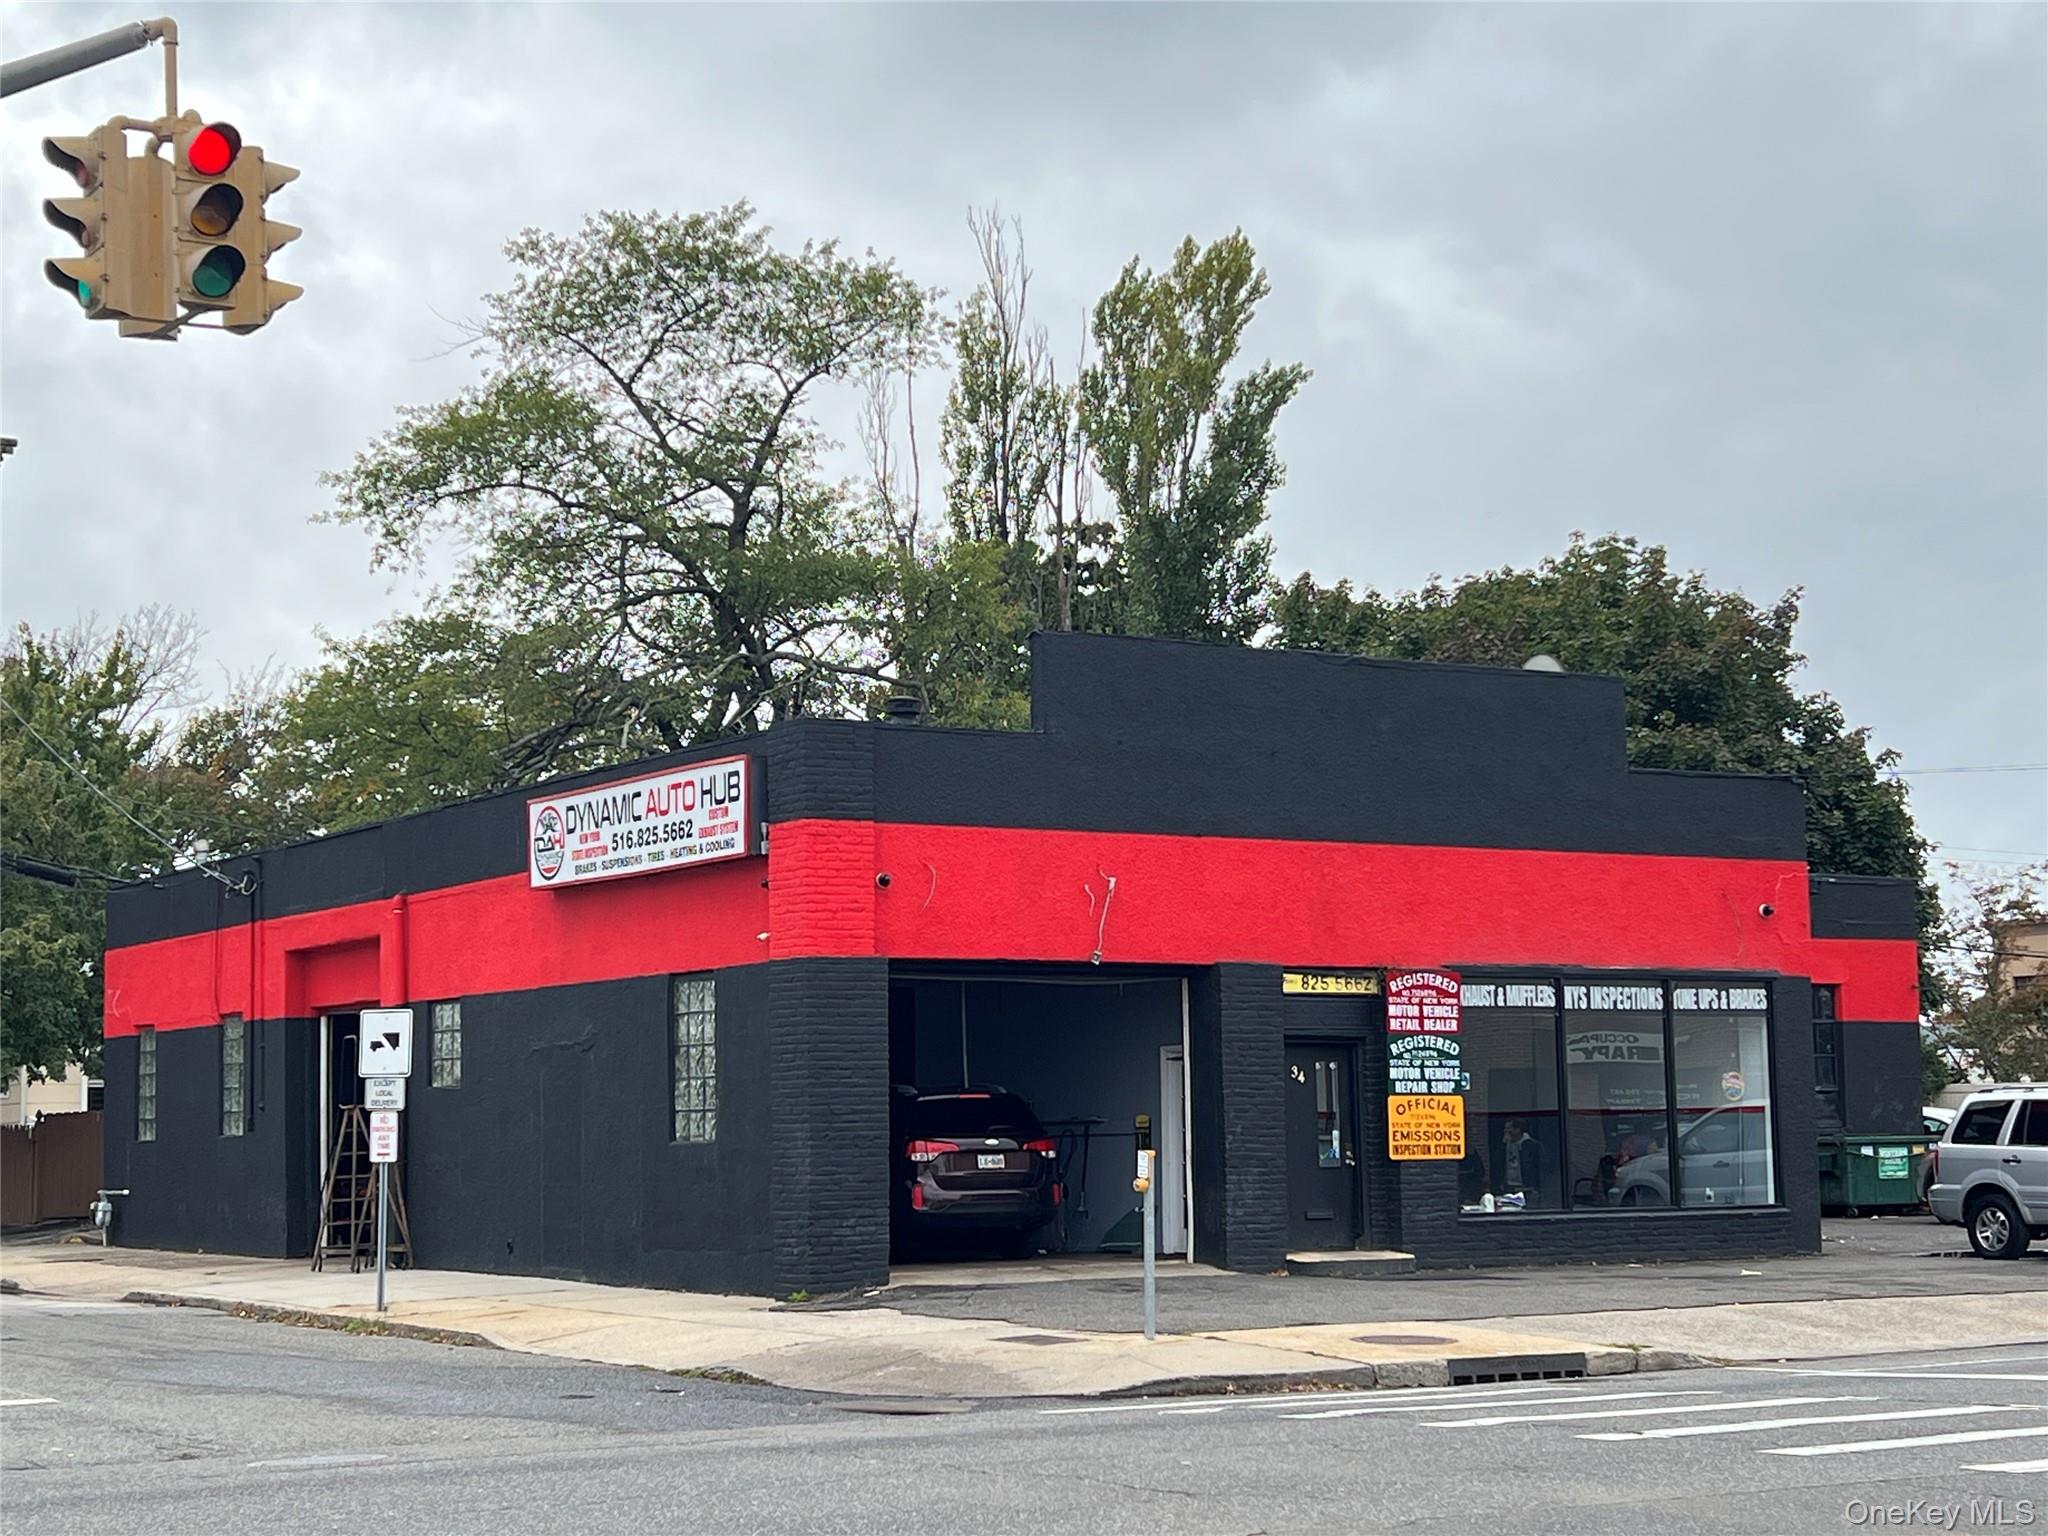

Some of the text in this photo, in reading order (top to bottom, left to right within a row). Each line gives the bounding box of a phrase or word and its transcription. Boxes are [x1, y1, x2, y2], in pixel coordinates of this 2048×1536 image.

[566, 770, 740, 834] DYNAMIC AUTO HUB
[612, 819, 693, 851] 516.825.5662
[574, 861, 597, 875] BRAKES
[601, 855, 643, 871] SUSPENSIONS
[647, 851, 665, 863] TIRES
[670, 845, 697, 859] HEATING
[705, 837, 735, 853] COOLING
[1389, 973, 1458, 993] REGISTERED
[1388, 996, 1409, 1004] STATE
[1496, 986, 1505, 1007] &
[1505, 984, 1556, 1008] MUFFLERS
[1563, 985, 1664, 1010] NYS INSPECTIONS
[1673, 988, 1768, 1010] TUNE UPS & BRAKES
[1388, 1004, 1459, 1018] MOTOR VEHICLE
[1389, 1018, 1458, 1031] RETAIL DEALER
[1390, 1035, 1460, 1056] REGISTERED
[1389, 1059, 1410, 1067] STATE
[1412, 1059, 1422, 1067] OF
[1441, 1059, 1460, 1067] YORK
[1290, 1065, 1306, 1084] 34
[1389, 1067, 1460, 1080] MOTOR VEHICLE
[374, 1079, 396, 1087] EXCEPT
[1395, 1081, 1456, 1093] REPAIR SHOP
[371, 1099, 398, 1107] DELIVERY
[1396, 1097, 1456, 1117] OFFICIAL
[1392, 1130, 1461, 1142] EMISSIONS
[1392, 1143, 1462, 1156] INSPECTION STATION
